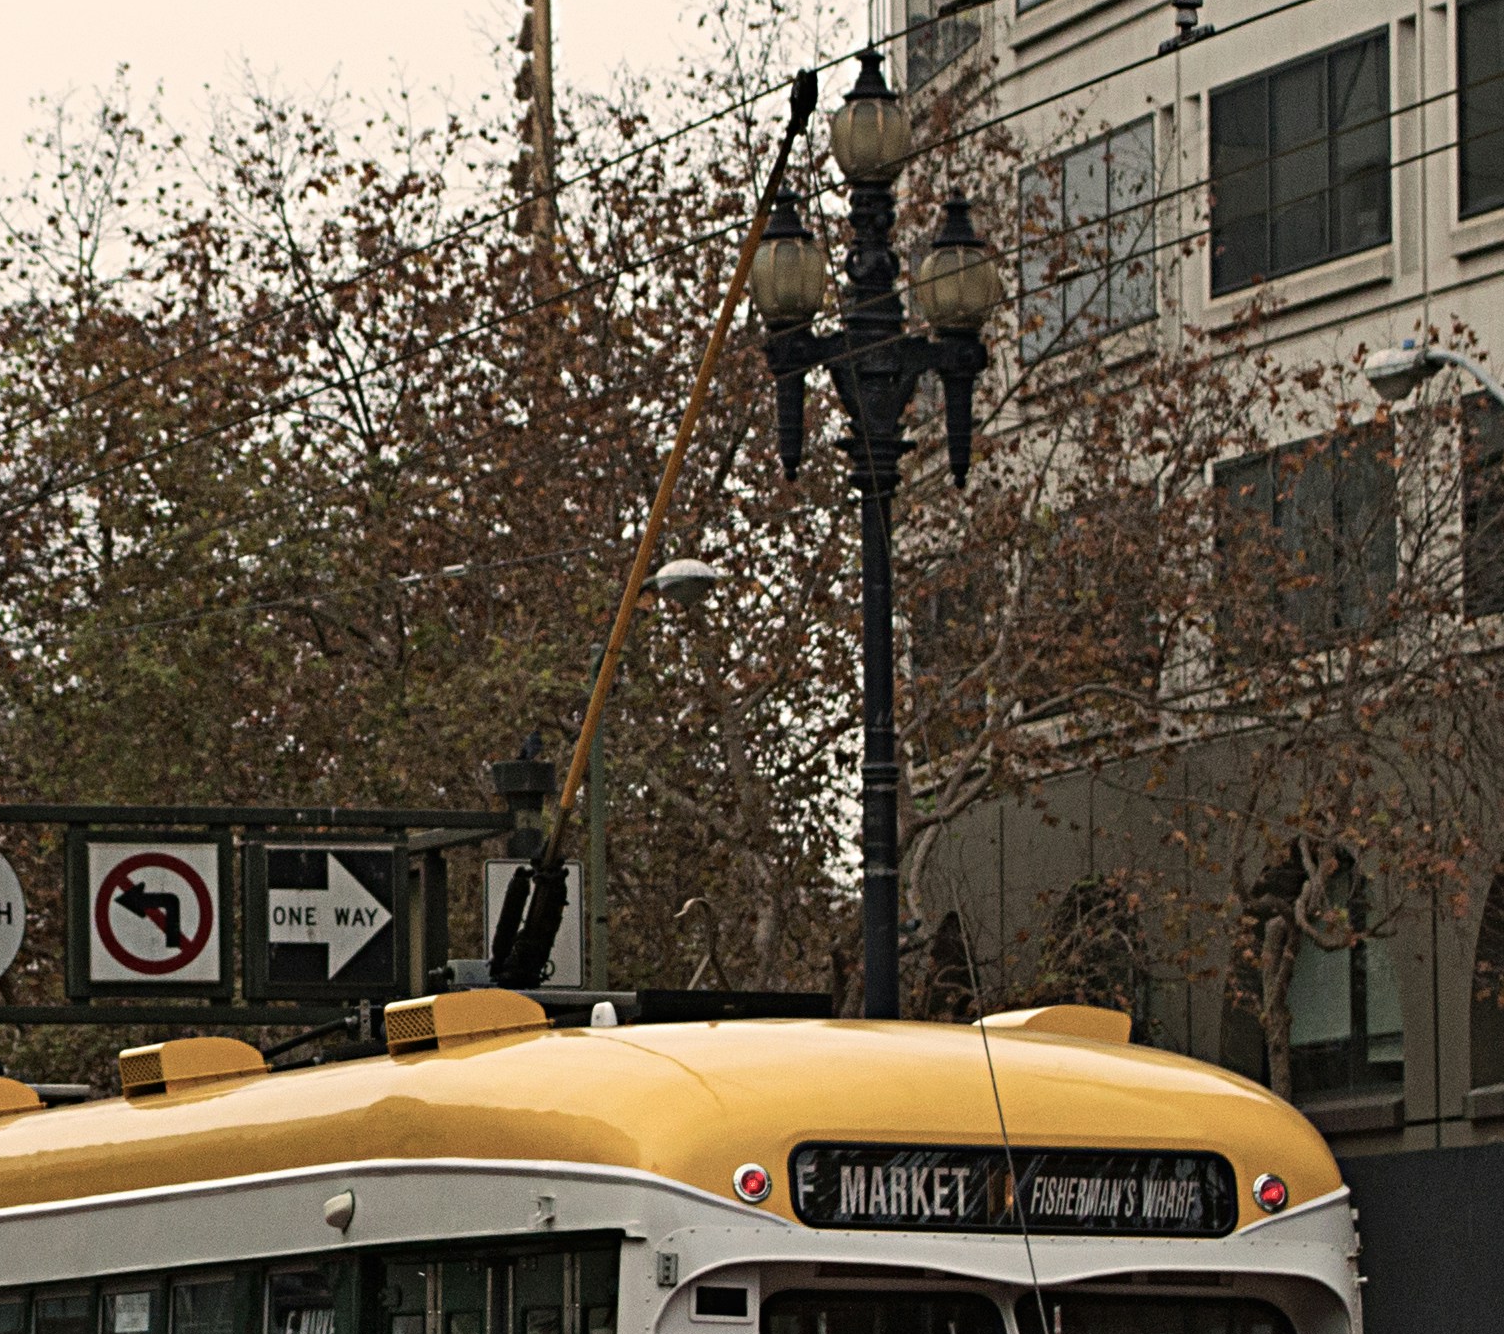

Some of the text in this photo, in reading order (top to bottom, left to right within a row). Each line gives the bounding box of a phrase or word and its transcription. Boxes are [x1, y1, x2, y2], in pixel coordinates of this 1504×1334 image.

[271, 904, 380, 929] ONE WAY
[795, 1162, 1203, 1221] F MARKET FISHERMAN'S WHARF
